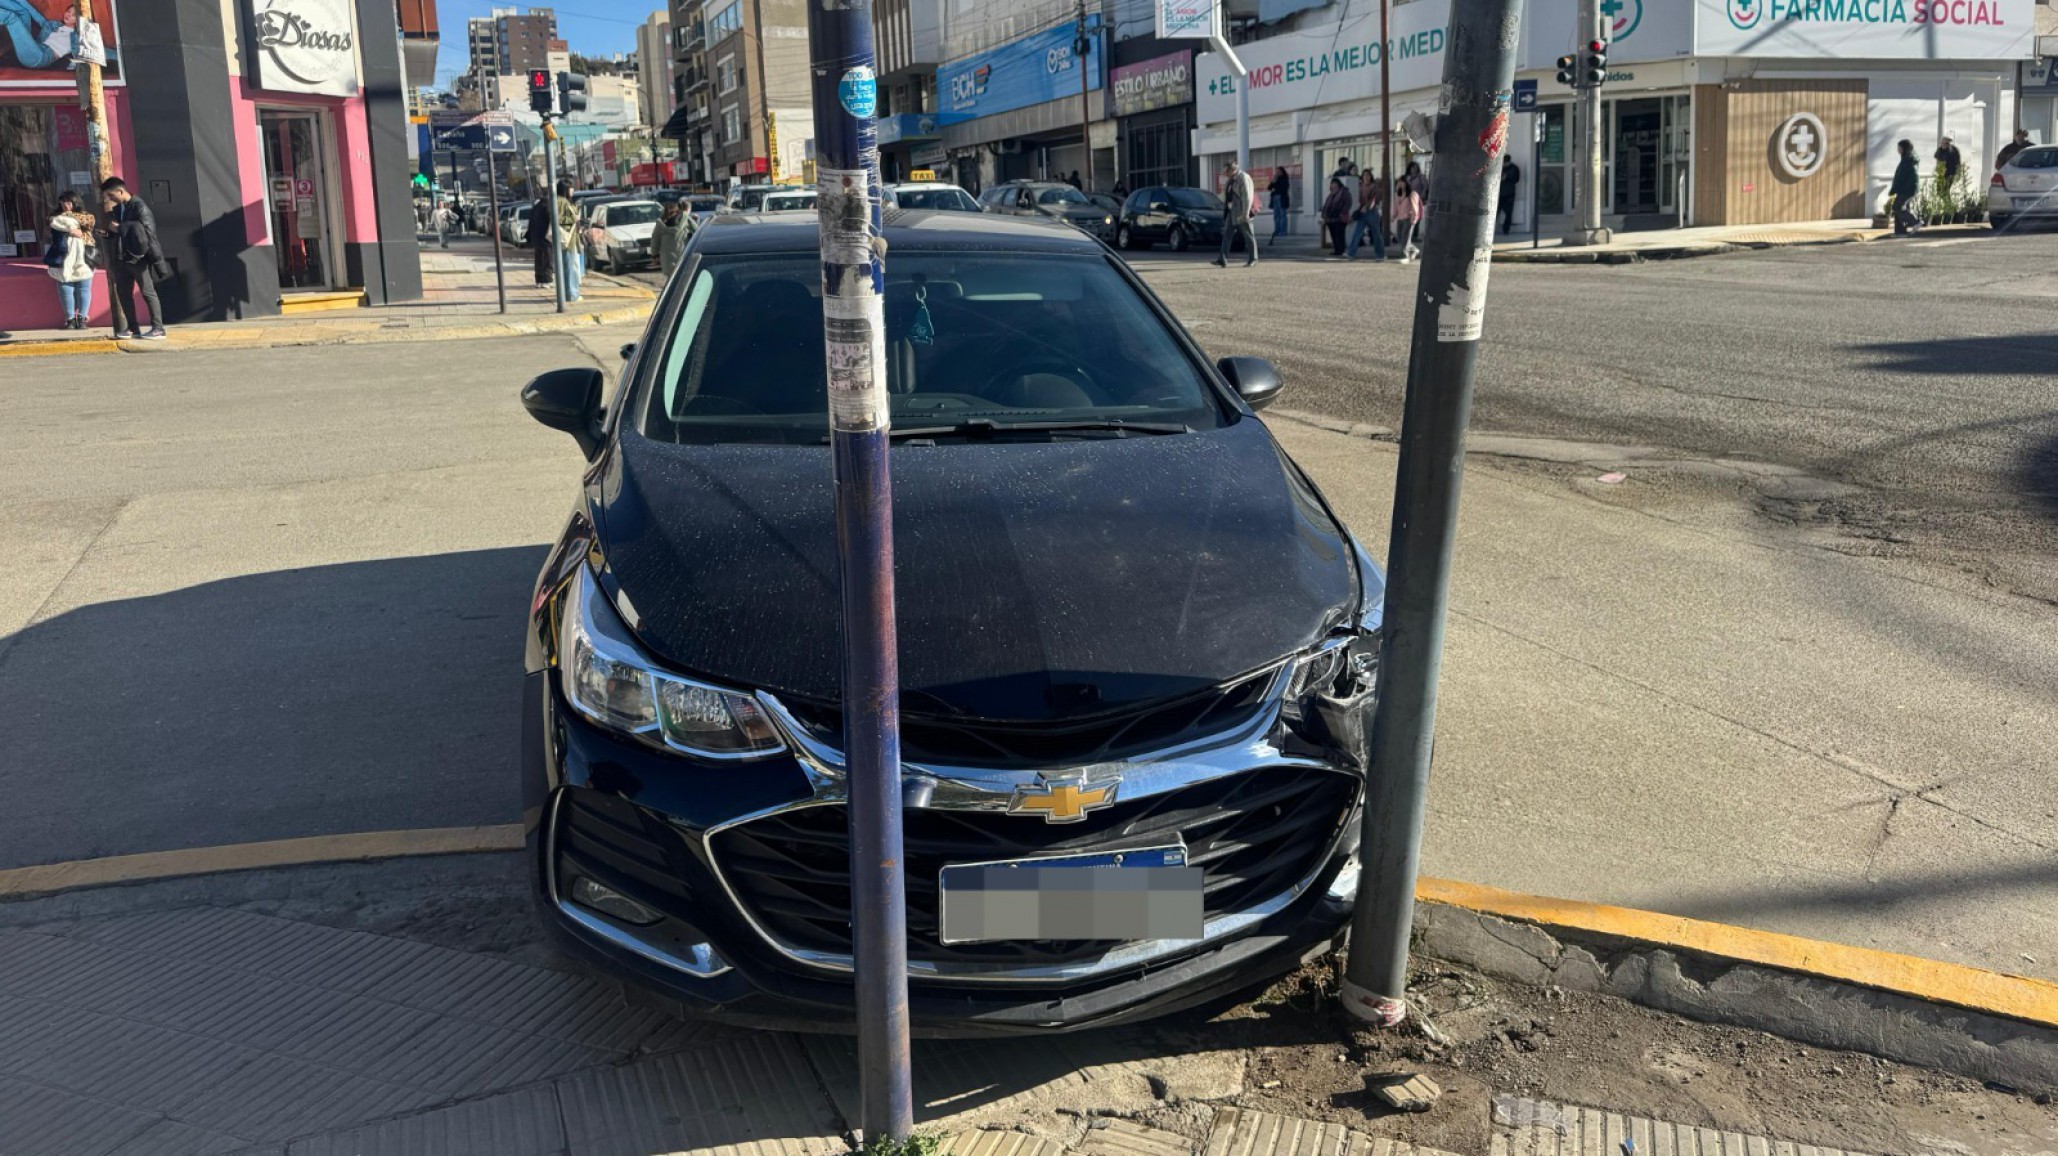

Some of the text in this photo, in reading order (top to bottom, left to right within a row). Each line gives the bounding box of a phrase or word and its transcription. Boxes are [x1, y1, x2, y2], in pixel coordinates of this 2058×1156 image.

[262, 10, 352, 51] Diosas
[1770, 0, 2004, 25] FARMACIA SOCIAL
[1220, 75, 1236, 95] EL
[1248, 64, 1283, 90] MOR
[1286, 58, 1305, 82] ES
[1310, 53, 1331, 77] LA
[1400, 28, 1444, 60] MED
[952, 71, 975, 103] BCH
